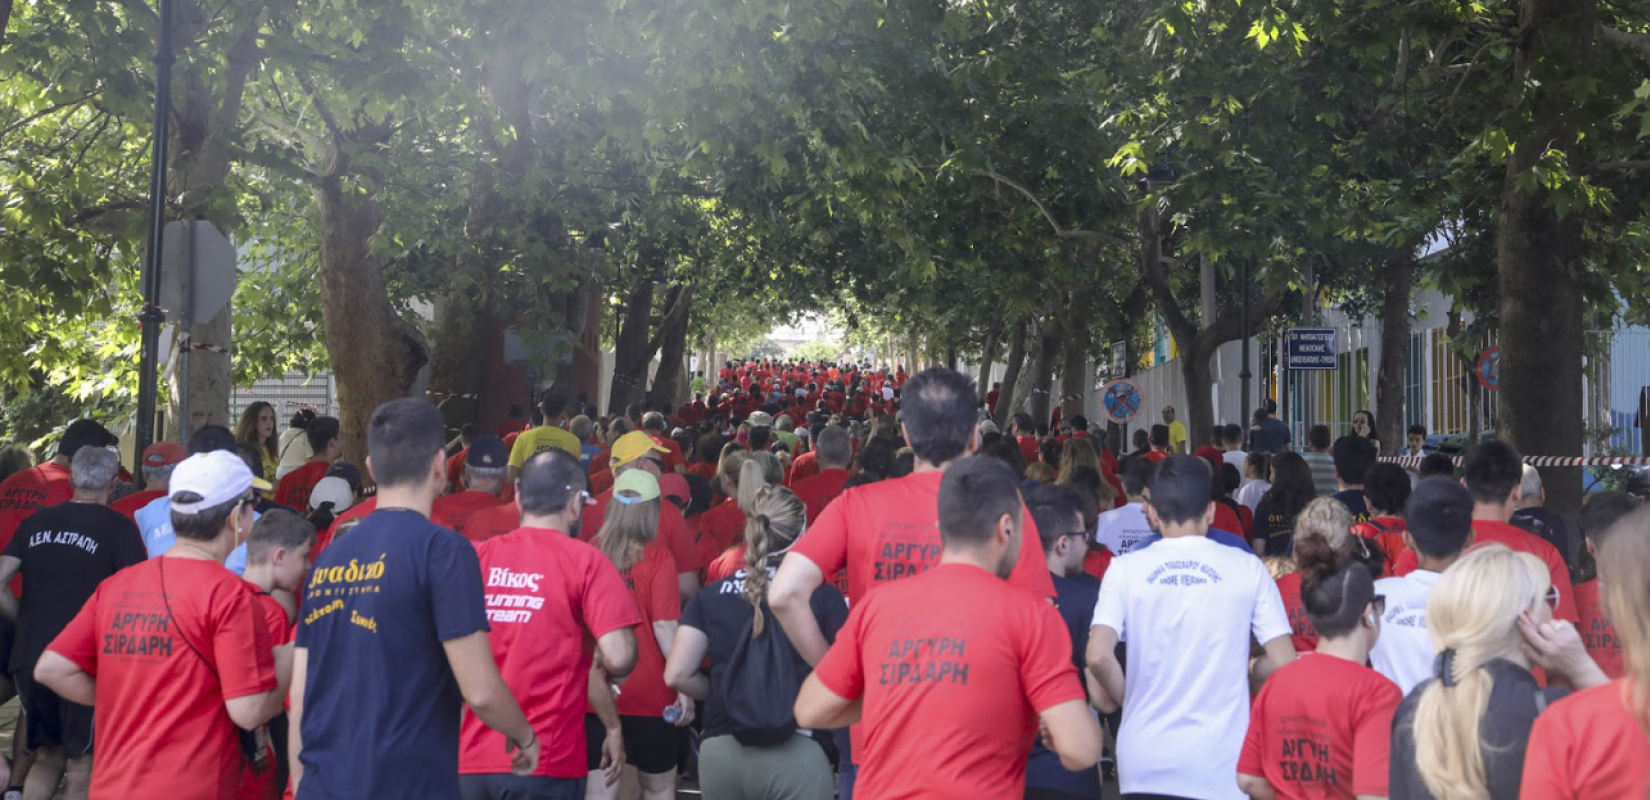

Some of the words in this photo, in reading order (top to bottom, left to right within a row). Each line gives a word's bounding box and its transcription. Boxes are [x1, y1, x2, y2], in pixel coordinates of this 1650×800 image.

[53, 530, 98, 555] ΑΣΤΡΑΠΗ
[881, 541, 941, 561] ΑΡΓΥΡ
[111, 611, 171, 634] ΑΡΓΥΡΗ
[103, 633, 173, 657] ΣΙΡΔΑΡΗ
[888, 637, 967, 659] ΑΡΓΥΡΗ
[879, 660, 969, 686] ΣΙΡΔΑΡΗ
